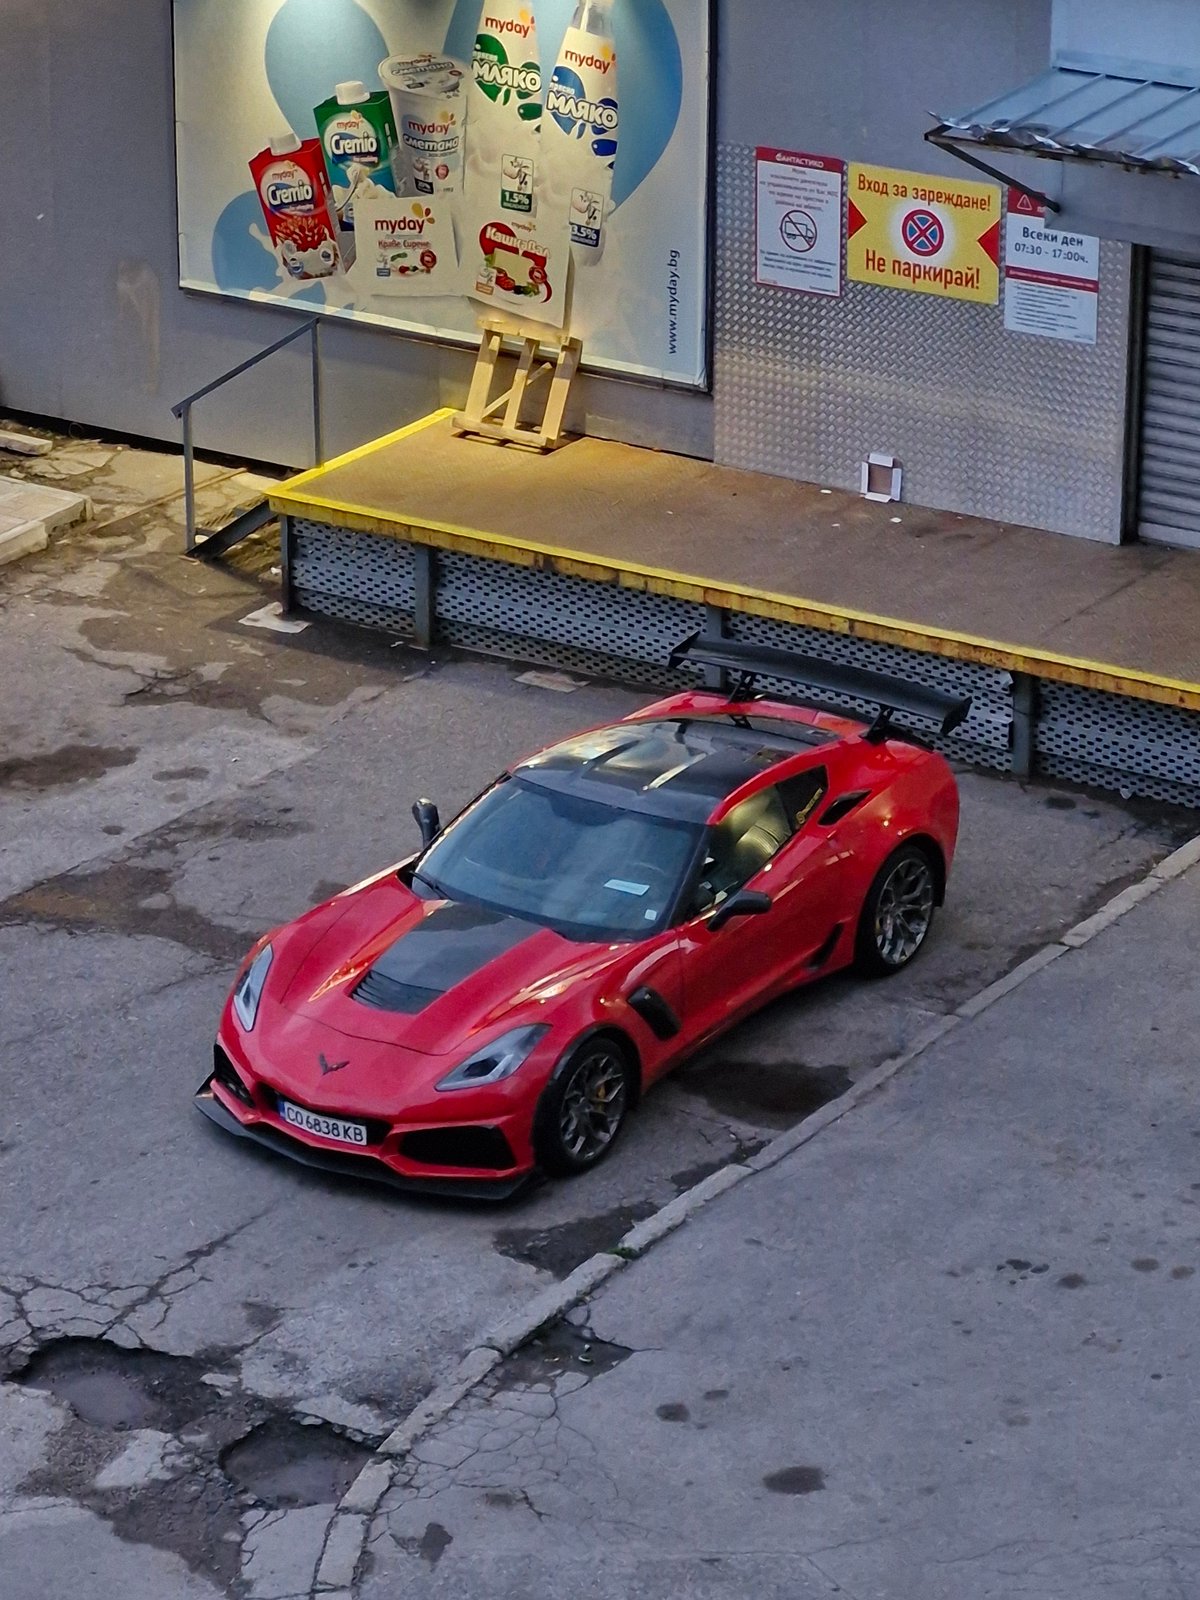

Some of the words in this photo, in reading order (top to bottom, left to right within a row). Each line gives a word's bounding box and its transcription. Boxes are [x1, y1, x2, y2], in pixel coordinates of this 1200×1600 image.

[485, 17, 530, 38] myday
[565, 50, 610, 74] myday
[472, 59, 542, 93] МЛЯКО
[546, 90, 618, 129] МЛЯКО
[408, 121, 450, 135] myday
[331, 131, 378, 155] Cremio
[267, 179, 313, 205] Cremio
[504, 191, 530, 205] 1.5%
[858, 173, 889, 197] Вход
[892, 184, 908, 198] за
[912, 187, 991, 212] зареждане!
[374, 216, 425, 234] myday
[571, 224, 597, 240] 3.5%
[1022, 227, 1058, 243] Всеки
[1061, 235, 1083, 247] ден
[1014, 242, 1042, 255] 07:30
[865, 248, 886, 273] Не
[892, 259, 980, 290] паркирай!
[666, 250, 680, 354] www.myday.bg
